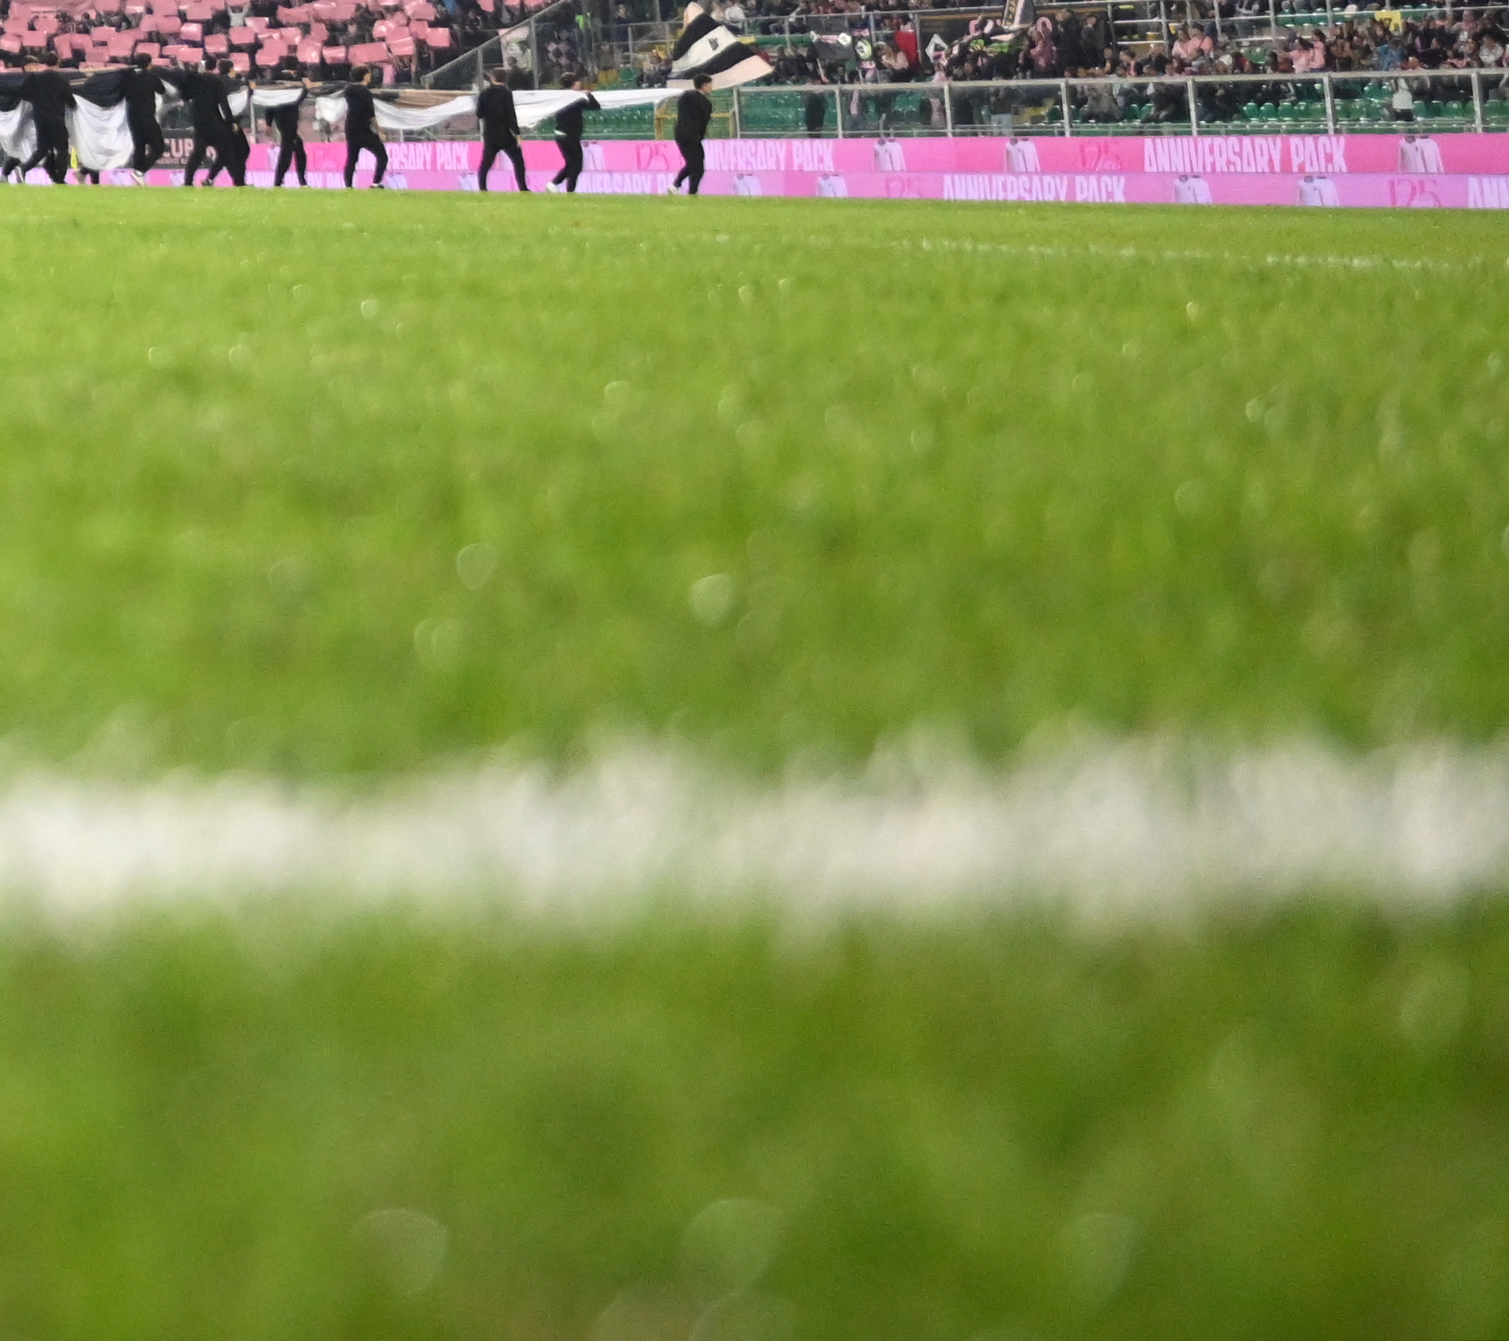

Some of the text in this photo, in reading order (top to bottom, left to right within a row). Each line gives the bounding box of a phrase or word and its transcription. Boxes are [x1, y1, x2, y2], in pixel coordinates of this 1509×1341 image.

[436, 142, 468, 170] PACK
[792, 140, 834, 171] PACK
[1144, 136, 1281, 173] ANNIVERSARY
[1290, 136, 1346, 173] PACK
[943, 174, 1068, 201] ANNIVERSARY
[1075, 175, 1126, 203] PACK
